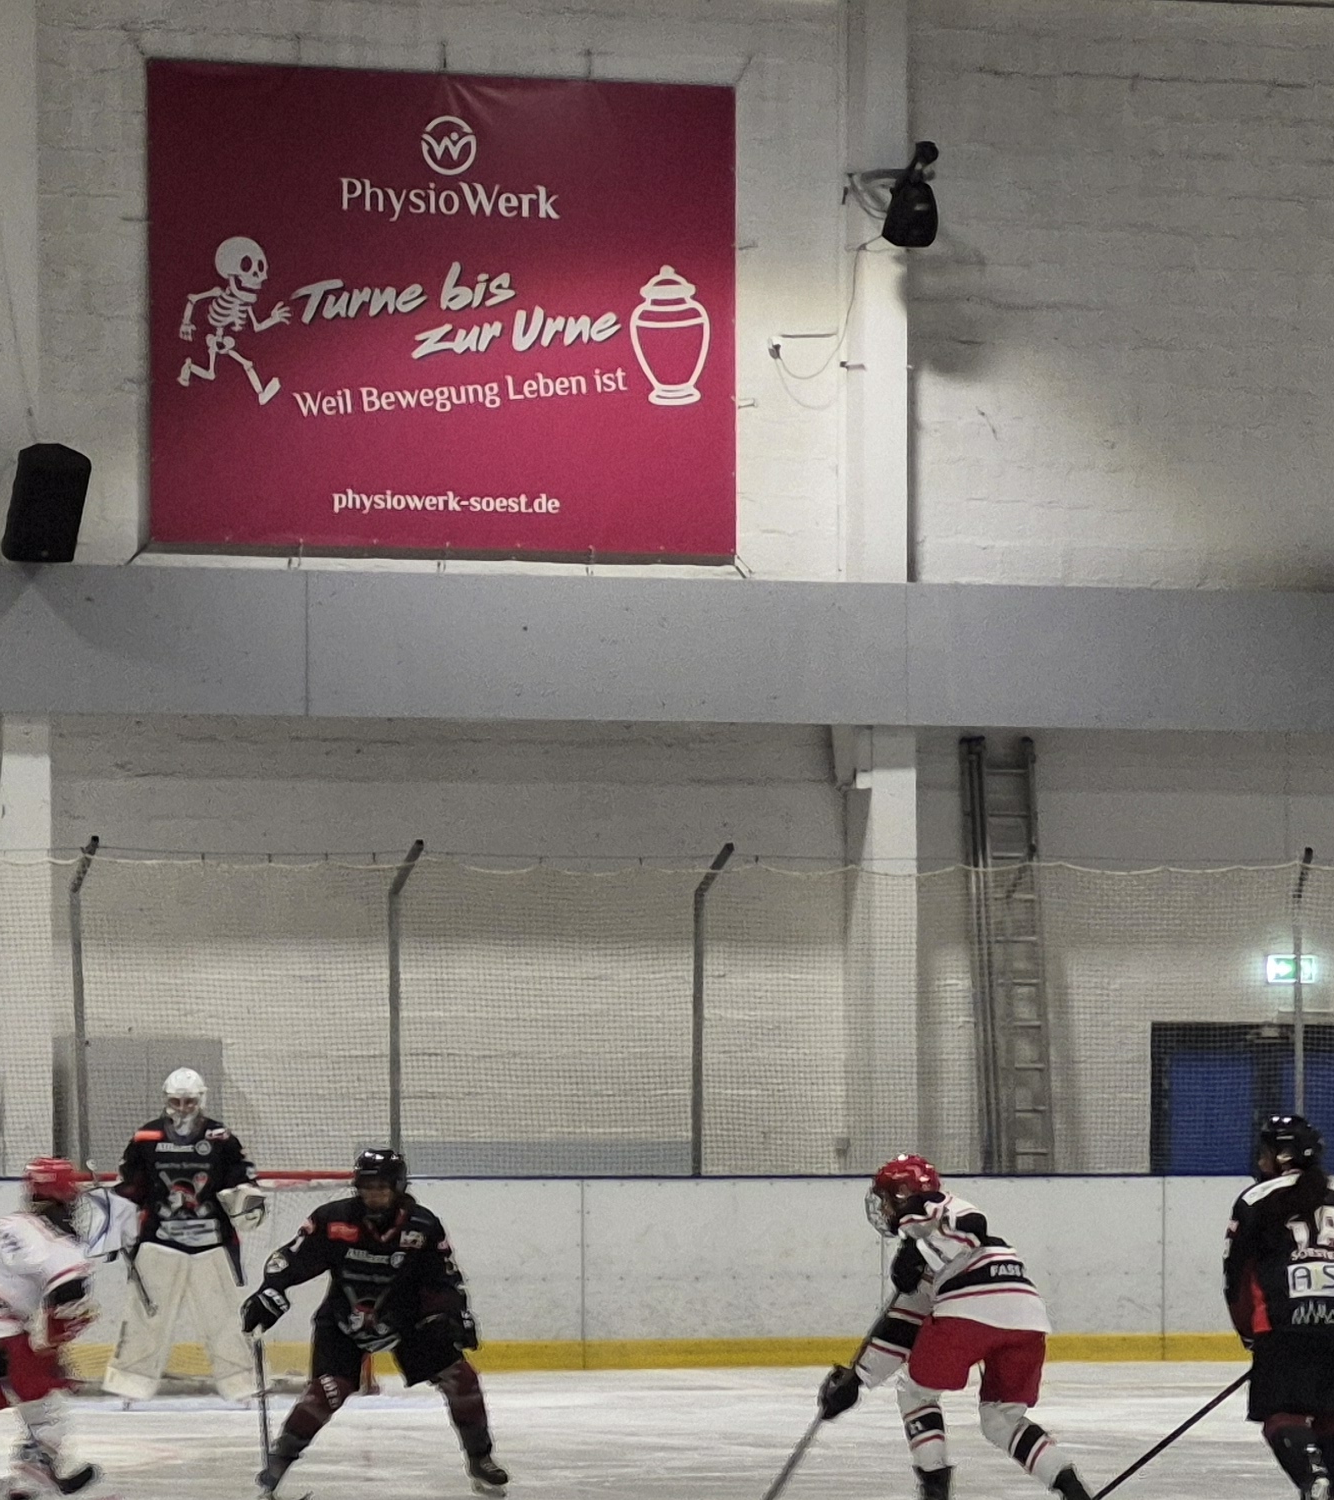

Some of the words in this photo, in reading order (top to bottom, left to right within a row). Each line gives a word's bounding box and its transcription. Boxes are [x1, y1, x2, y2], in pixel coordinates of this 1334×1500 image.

[340, 176, 561, 222] PhysioWerk
[290, 277, 427, 325] Turne
[440, 262, 517, 312] bis
[411, 320, 501, 361] zur
[510, 305, 622, 352] Urne
[292, 387, 354, 418] Weil
[361, 379, 501, 415] Bewegung
[506, 374, 588, 402] Leben
[593, 368, 628, 394] ist
[331, 486, 562, 516] physiowerk-soest.de
